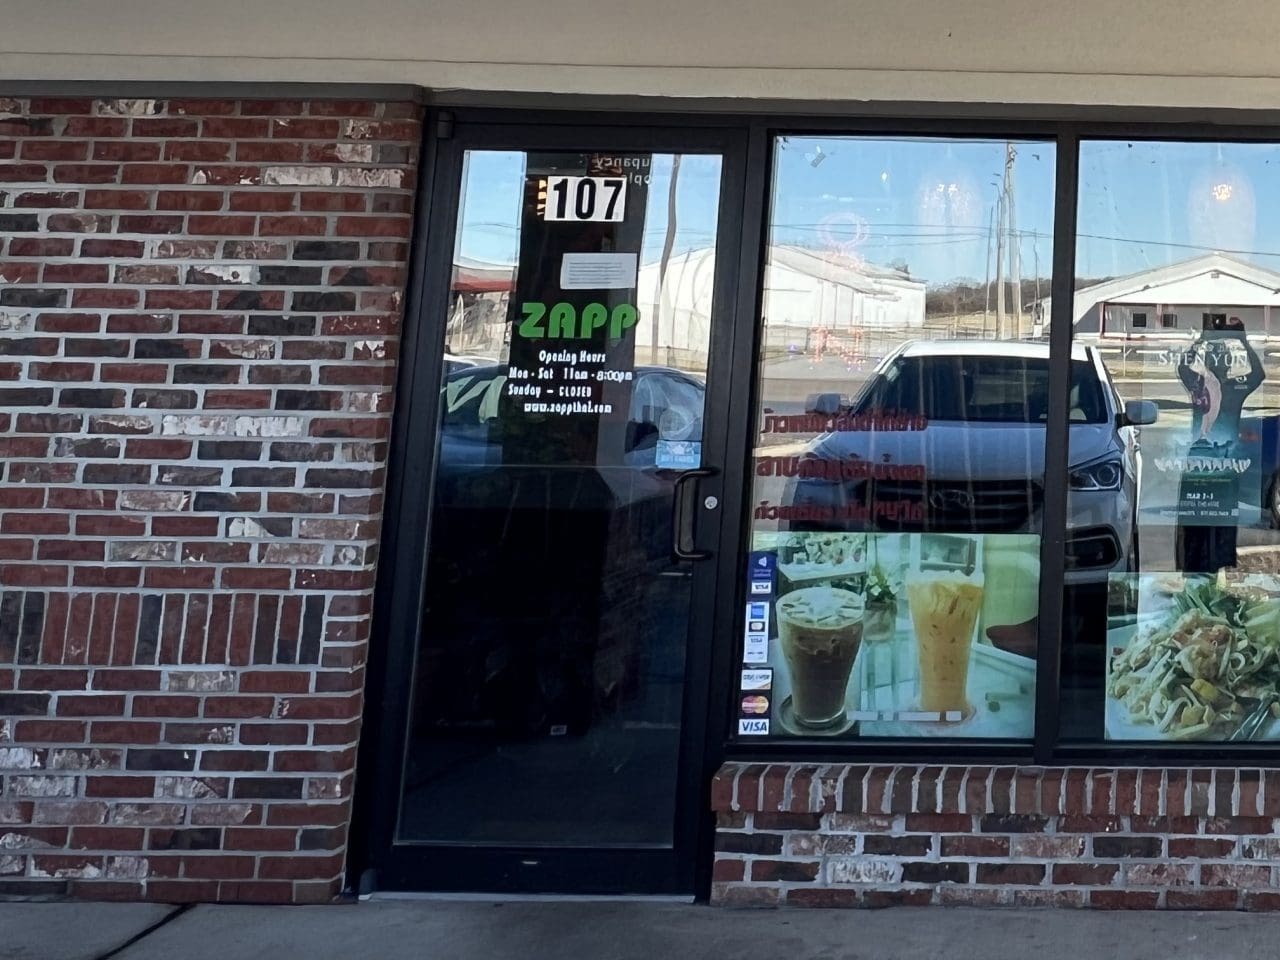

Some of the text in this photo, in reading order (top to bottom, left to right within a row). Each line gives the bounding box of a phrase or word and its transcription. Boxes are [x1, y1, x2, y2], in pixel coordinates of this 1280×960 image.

[553, 177, 624, 220] 107
[518, 302, 641, 339] ZAPP
[539, 350, 607, 366] Opening Hours
[1158, 352, 1248, 367] SHEN YUN
[508, 367, 529, 380] Mon
[537, 367, 555, 380] Sat
[563, 367, 589, 380] 11am
[596, 370, 634, 383] 8:00pm
[508, 383, 542, 398] Sunday
[558, 386, 592, 398] CLOSED
[742, 721, 767, 732] VISA
